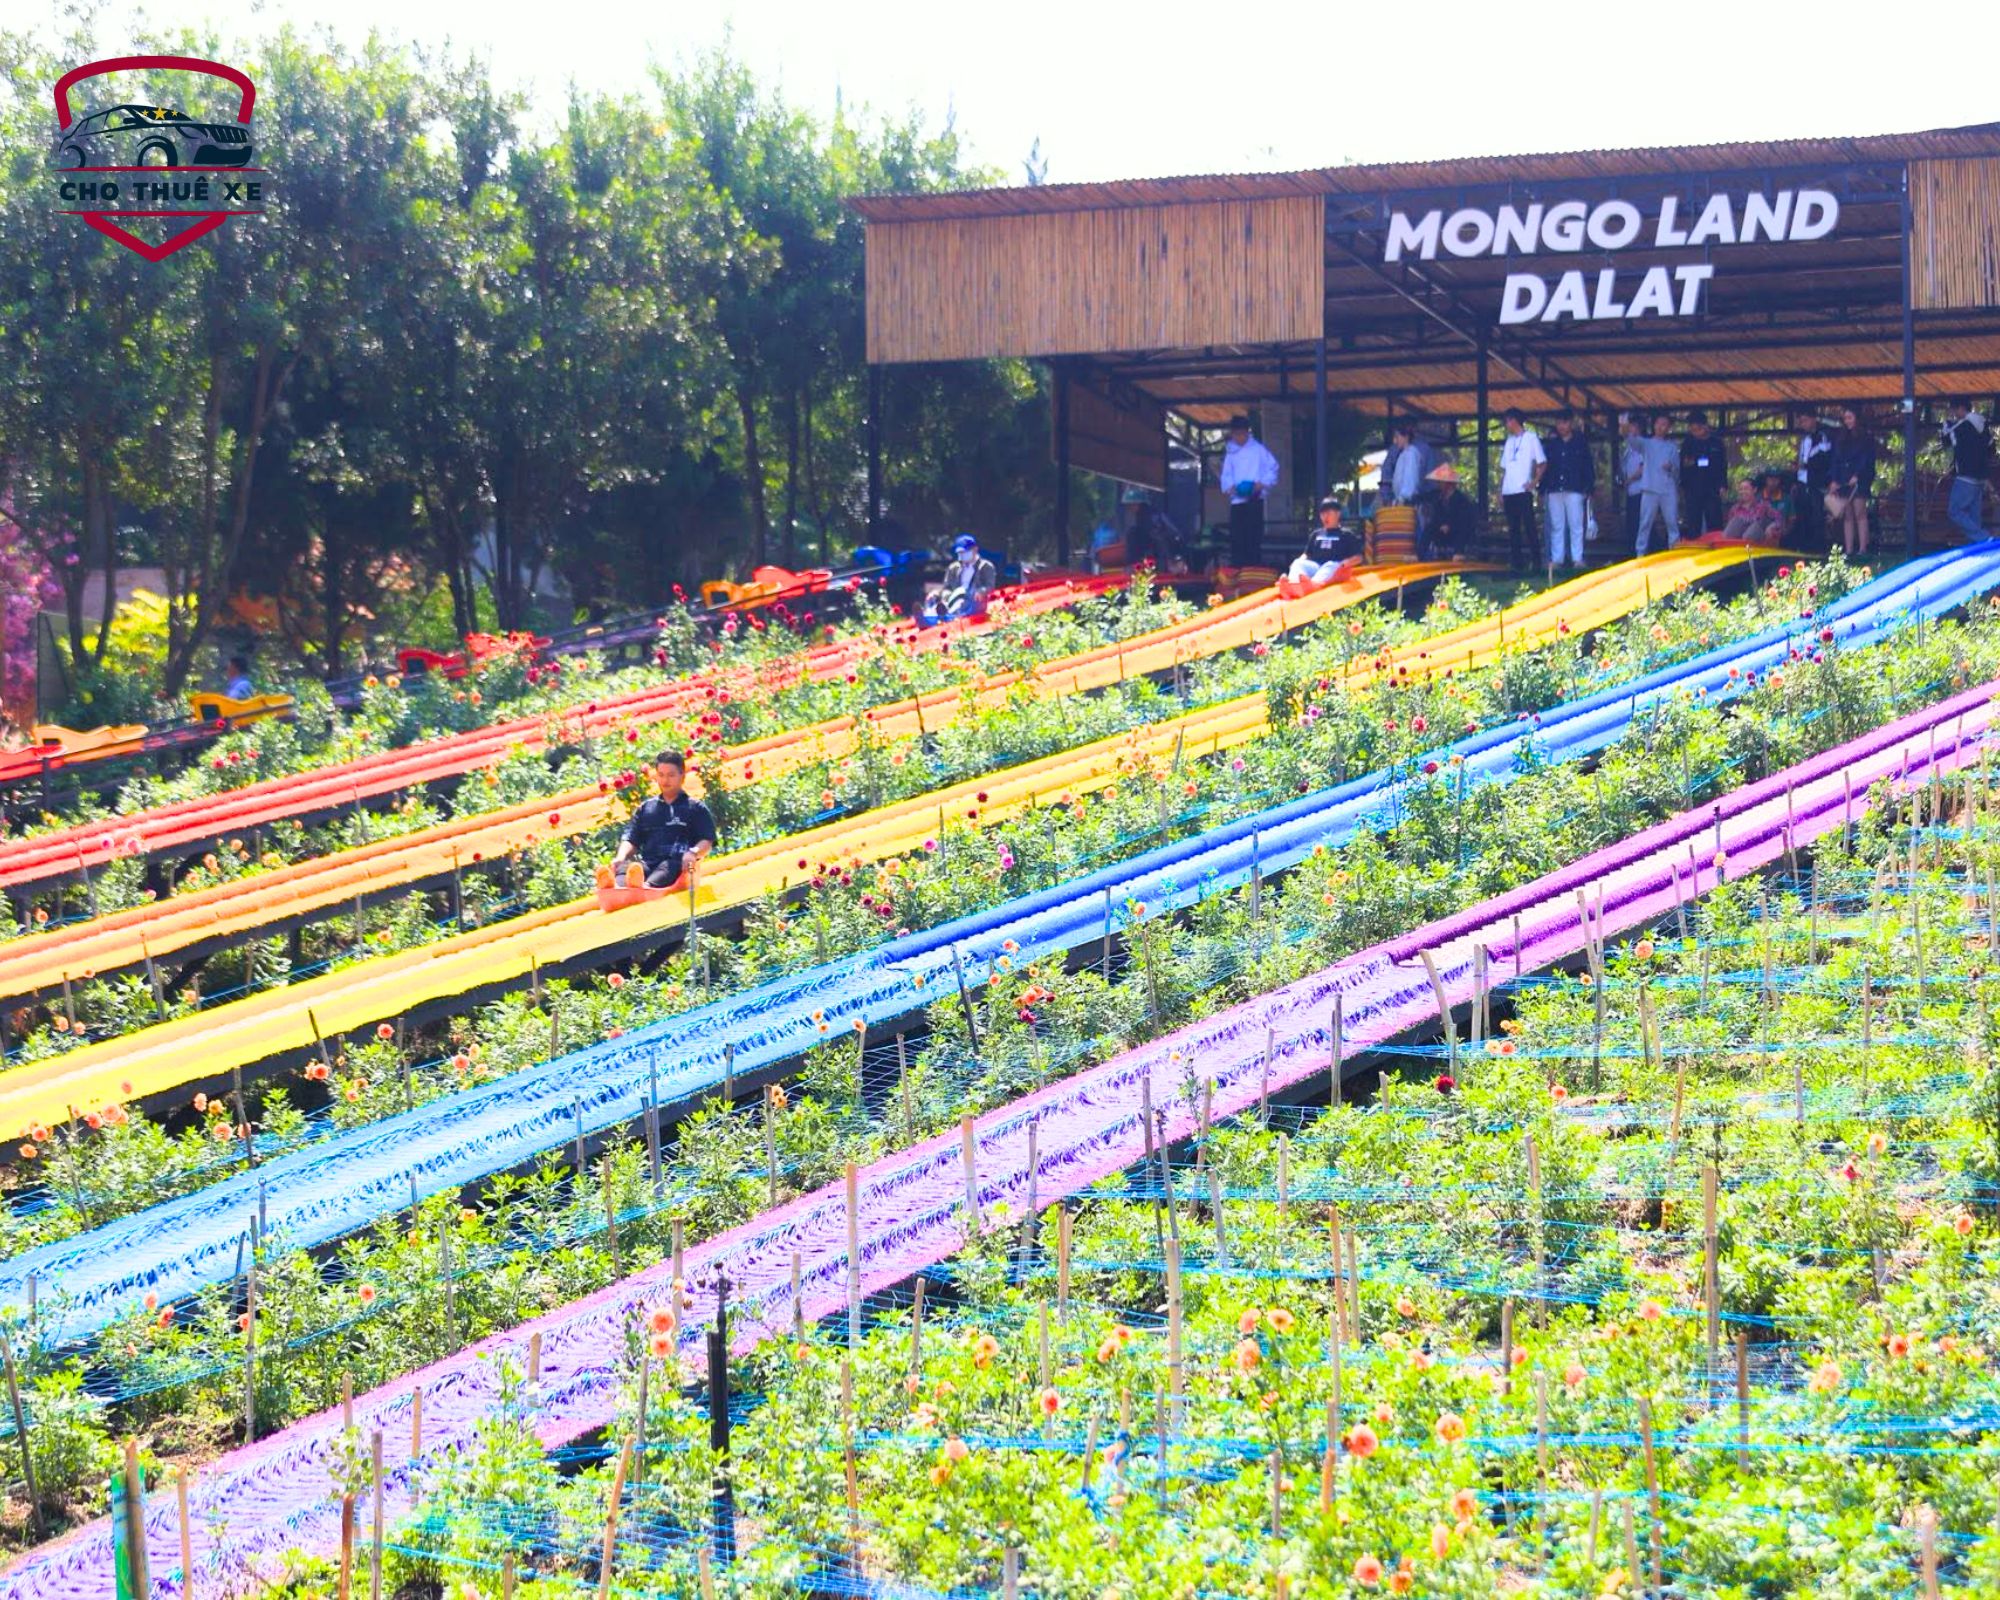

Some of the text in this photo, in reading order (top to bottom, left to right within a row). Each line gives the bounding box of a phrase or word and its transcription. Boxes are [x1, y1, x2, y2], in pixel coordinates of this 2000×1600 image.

[1384, 189, 1839, 262] MONGO LAND
[1499, 264, 1713, 325] DALAT
